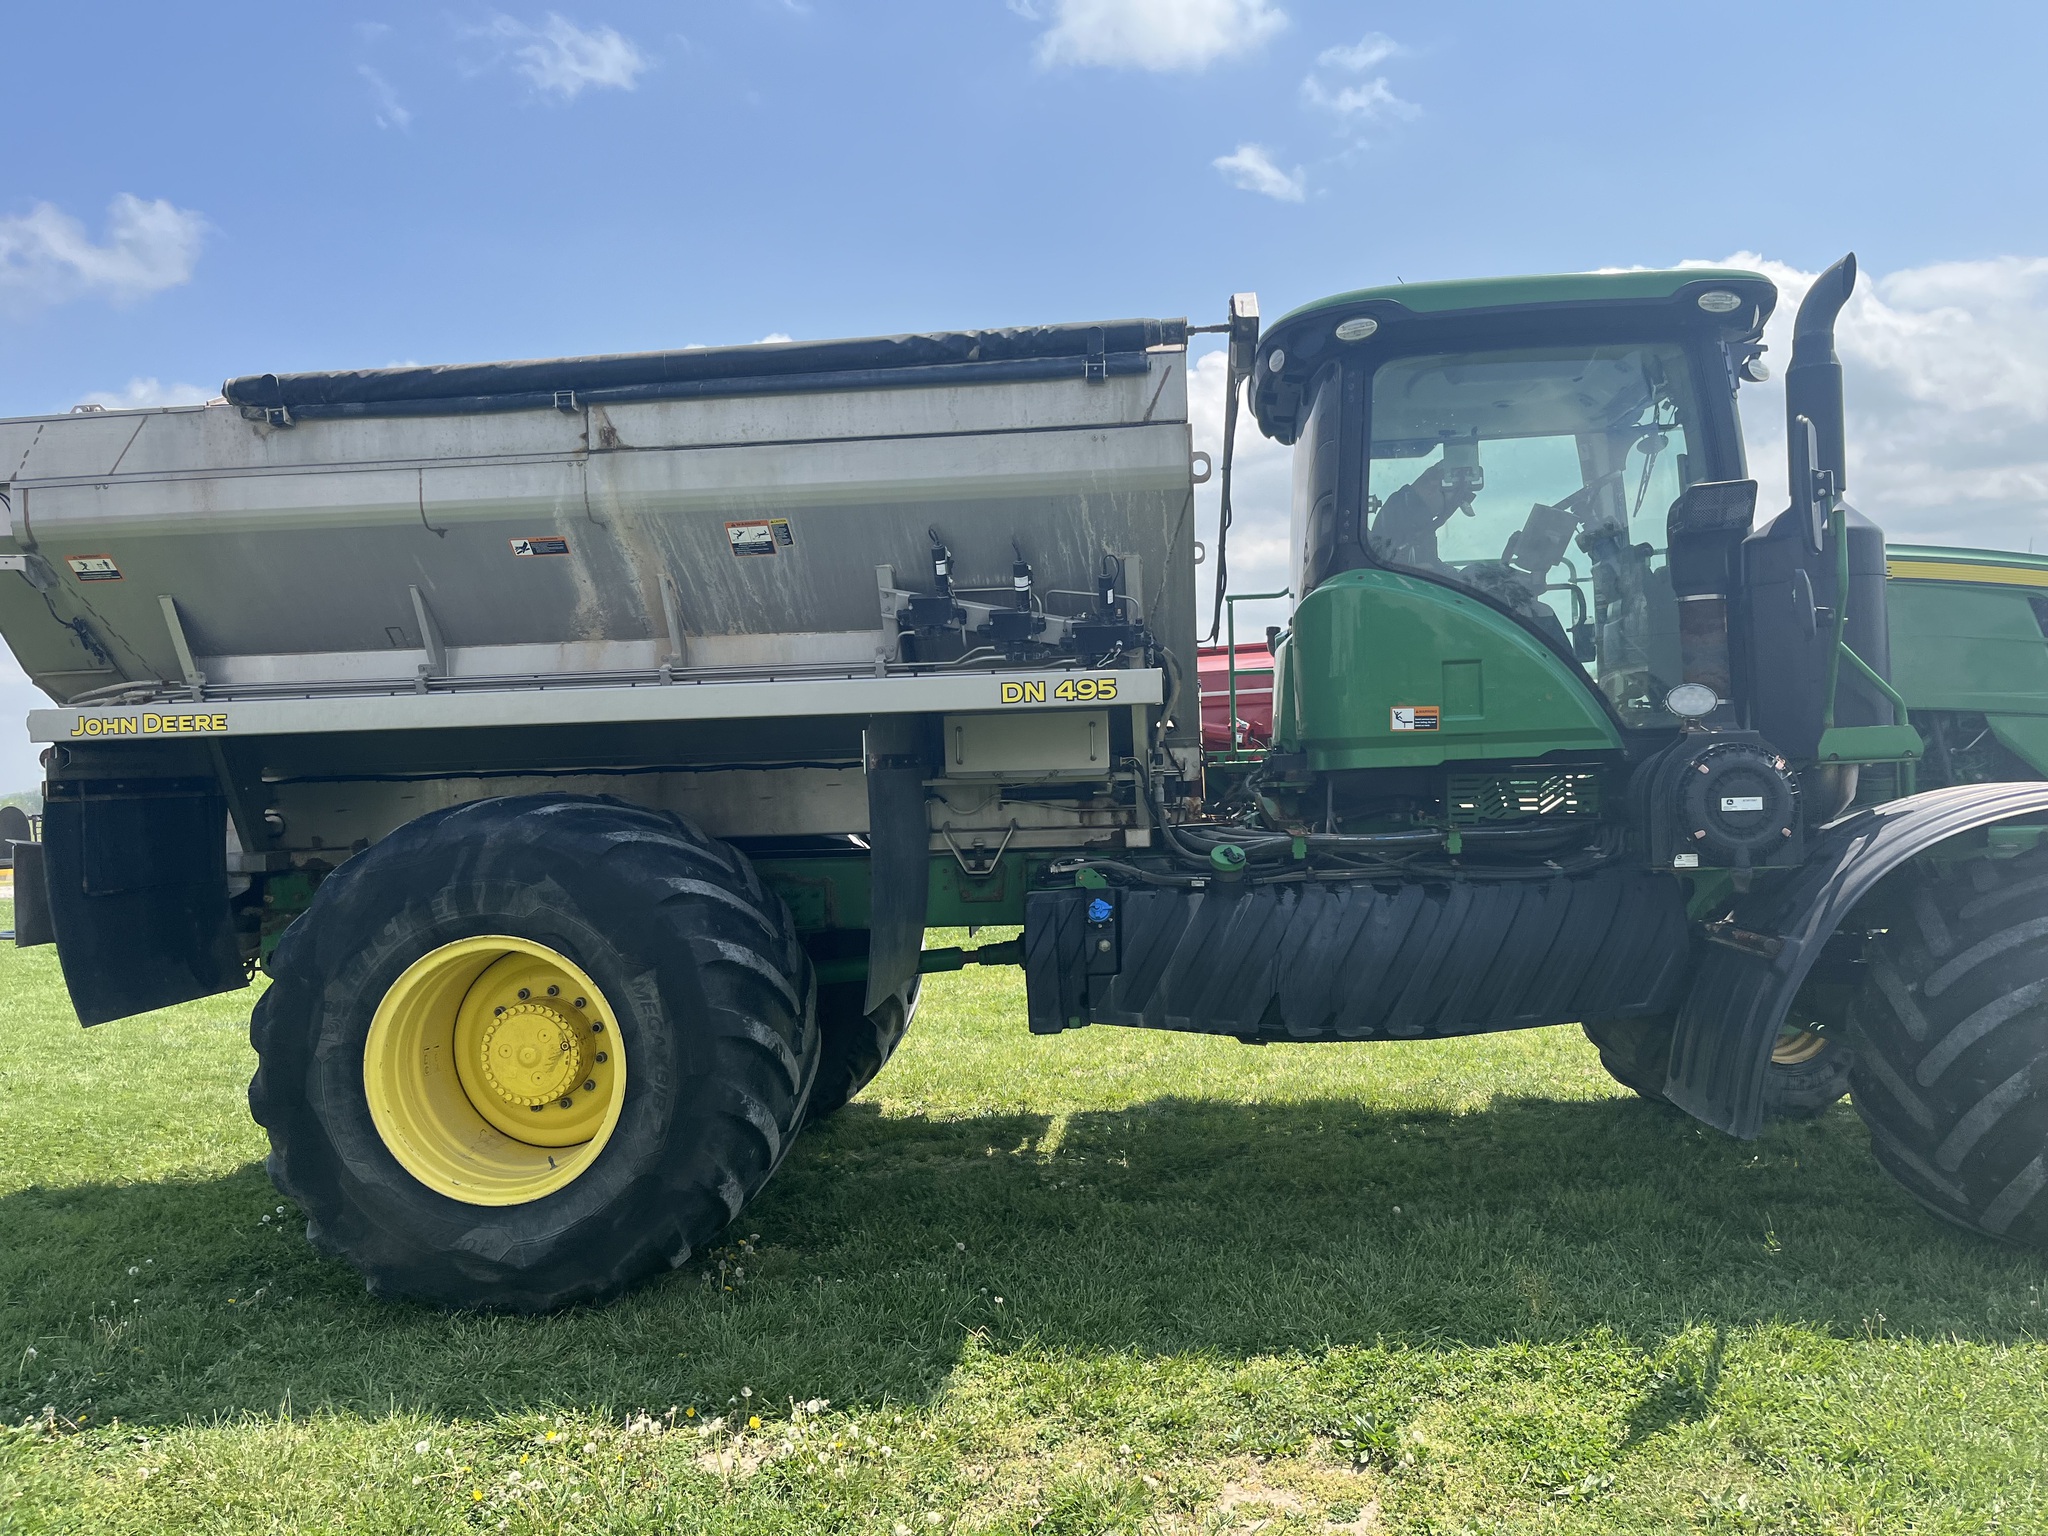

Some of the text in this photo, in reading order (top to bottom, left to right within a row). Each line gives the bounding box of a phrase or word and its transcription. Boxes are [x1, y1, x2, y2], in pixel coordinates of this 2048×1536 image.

[1001, 678, 1117, 704] DN 495
[71, 713, 228, 736] JOHN DEERE
